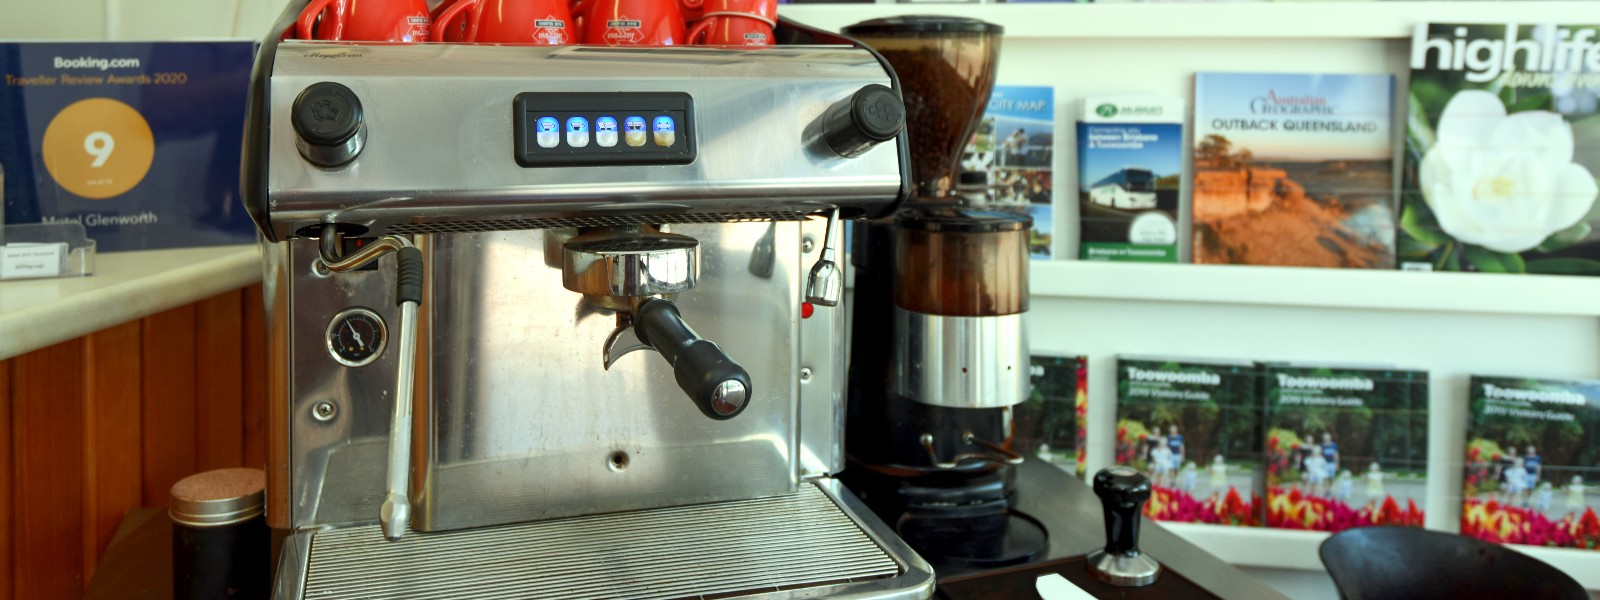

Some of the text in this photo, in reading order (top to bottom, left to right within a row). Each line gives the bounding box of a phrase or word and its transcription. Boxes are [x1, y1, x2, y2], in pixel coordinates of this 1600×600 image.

[54, 56, 140, 70] Booking.com
[5, 72, 188, 87] Traveller Review Awards 2020
[989, 99, 1046, 112] CITY MAP
[1268, 88, 1328, 106] Australian
[1212, 118, 1378, 134] OUTBACK QUEENSLAND
[84, 131, 115, 168] 9
[85, 210, 158, 228] Glenworth
[1126, 366, 1221, 386] Toowoomba
[1277, 373, 1375, 391] Toowoomba
[1483, 383, 1586, 406] Toowoomba
